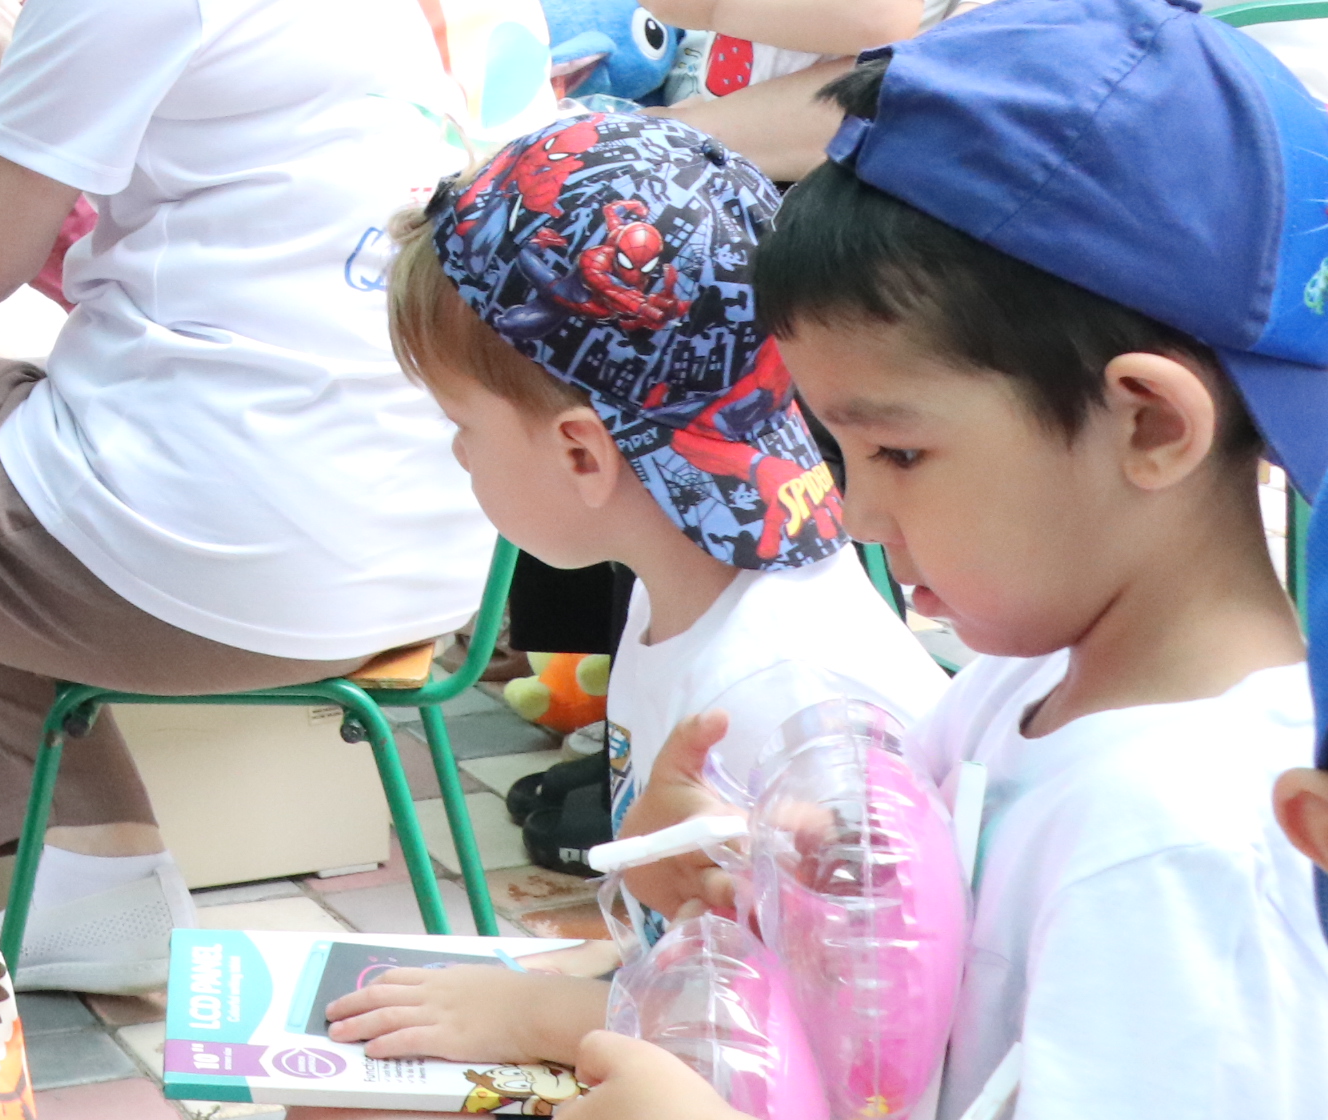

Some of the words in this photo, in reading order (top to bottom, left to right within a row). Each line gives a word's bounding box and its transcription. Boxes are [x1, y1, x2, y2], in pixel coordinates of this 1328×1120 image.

[615, 426, 658, 452] PIDEY
[777, 461, 834, 536] SPIDE
[190, 944, 223, 994] PANEL
[189, 995, 222, 1029] LCD
